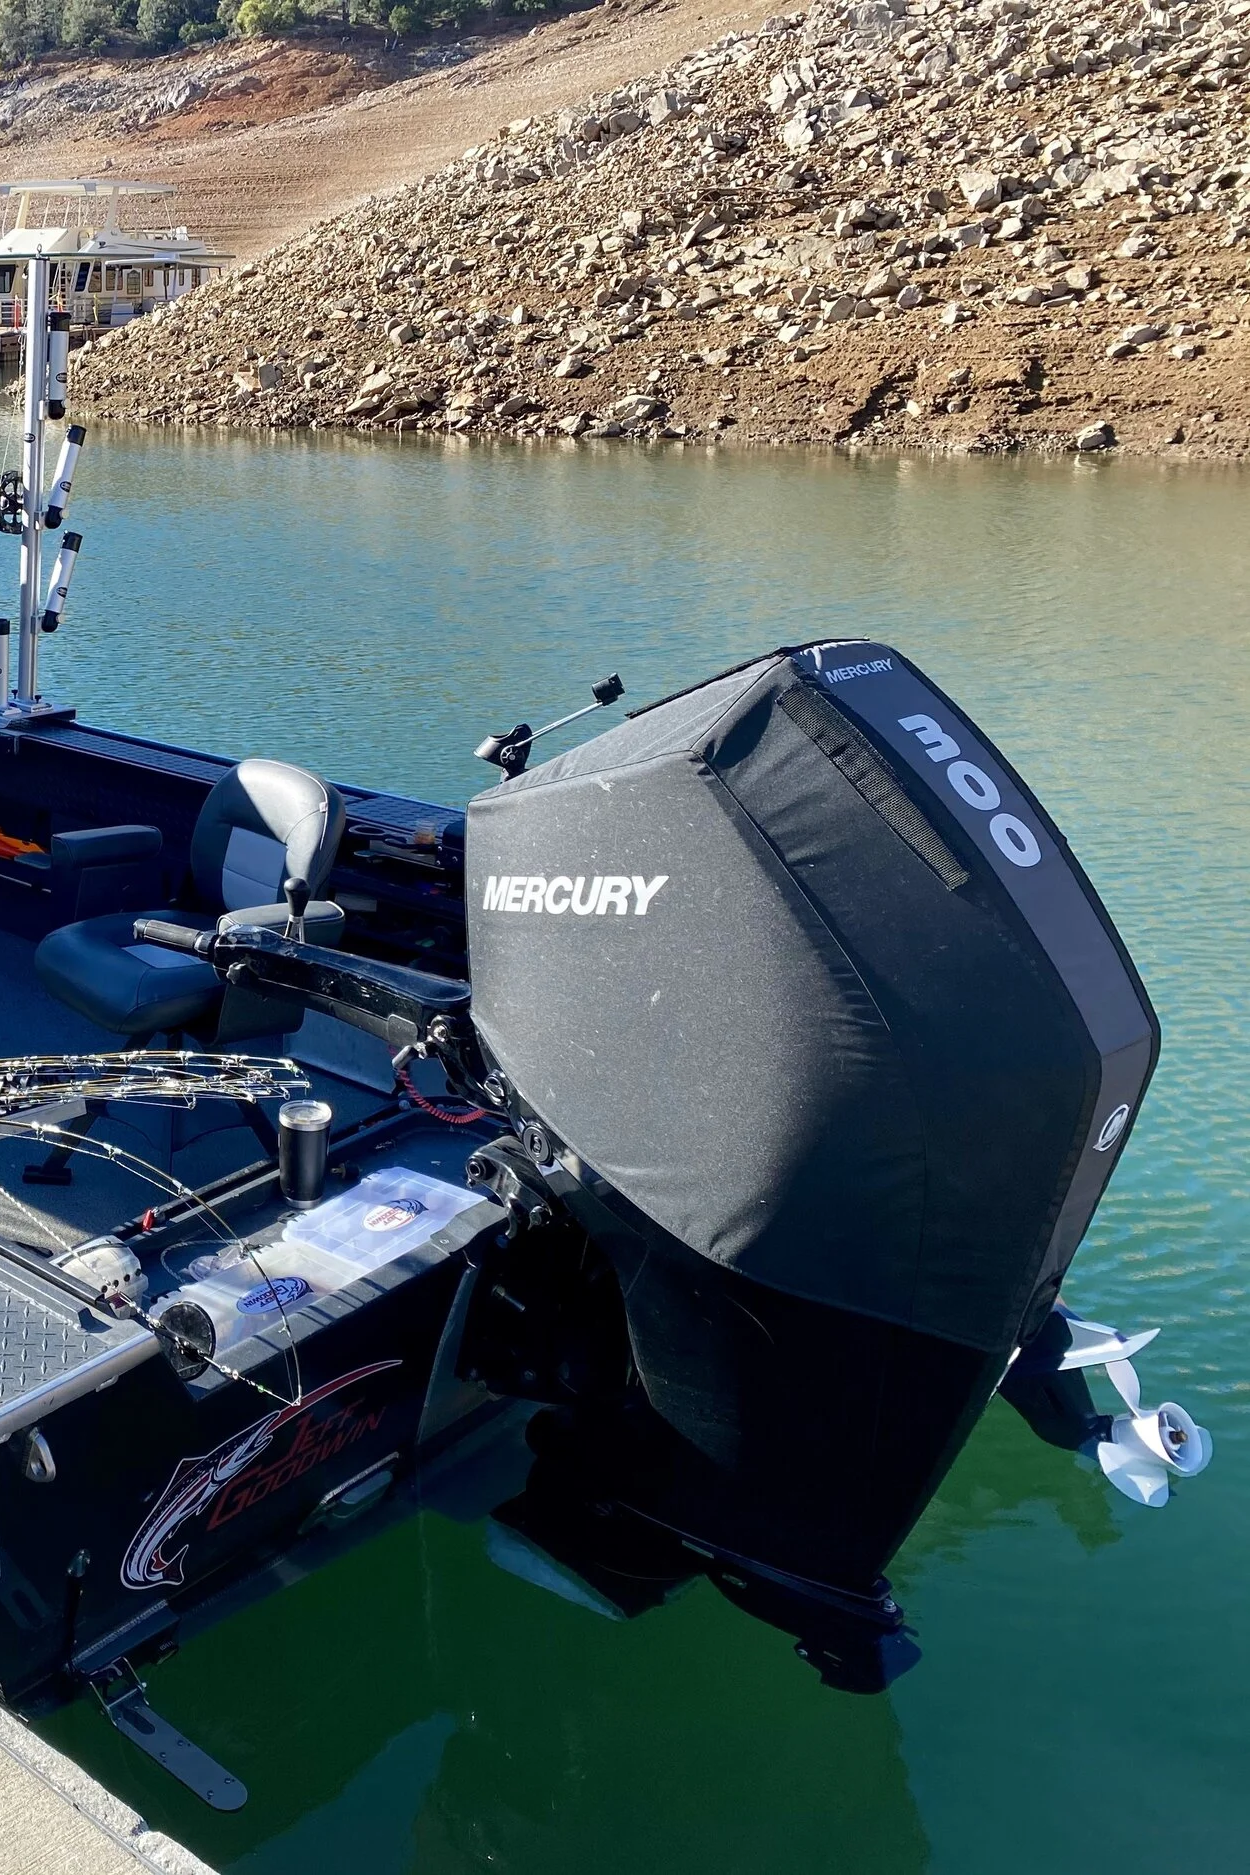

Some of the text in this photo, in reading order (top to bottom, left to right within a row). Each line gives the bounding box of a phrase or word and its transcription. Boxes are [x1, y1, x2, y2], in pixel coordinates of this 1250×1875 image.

[825, 658, 894, 684] MERCURY
[897, 713, 1042, 868] 300
[482, 875, 670, 916] MERCURY
[206, 1406, 387, 1532] GOODWIN
